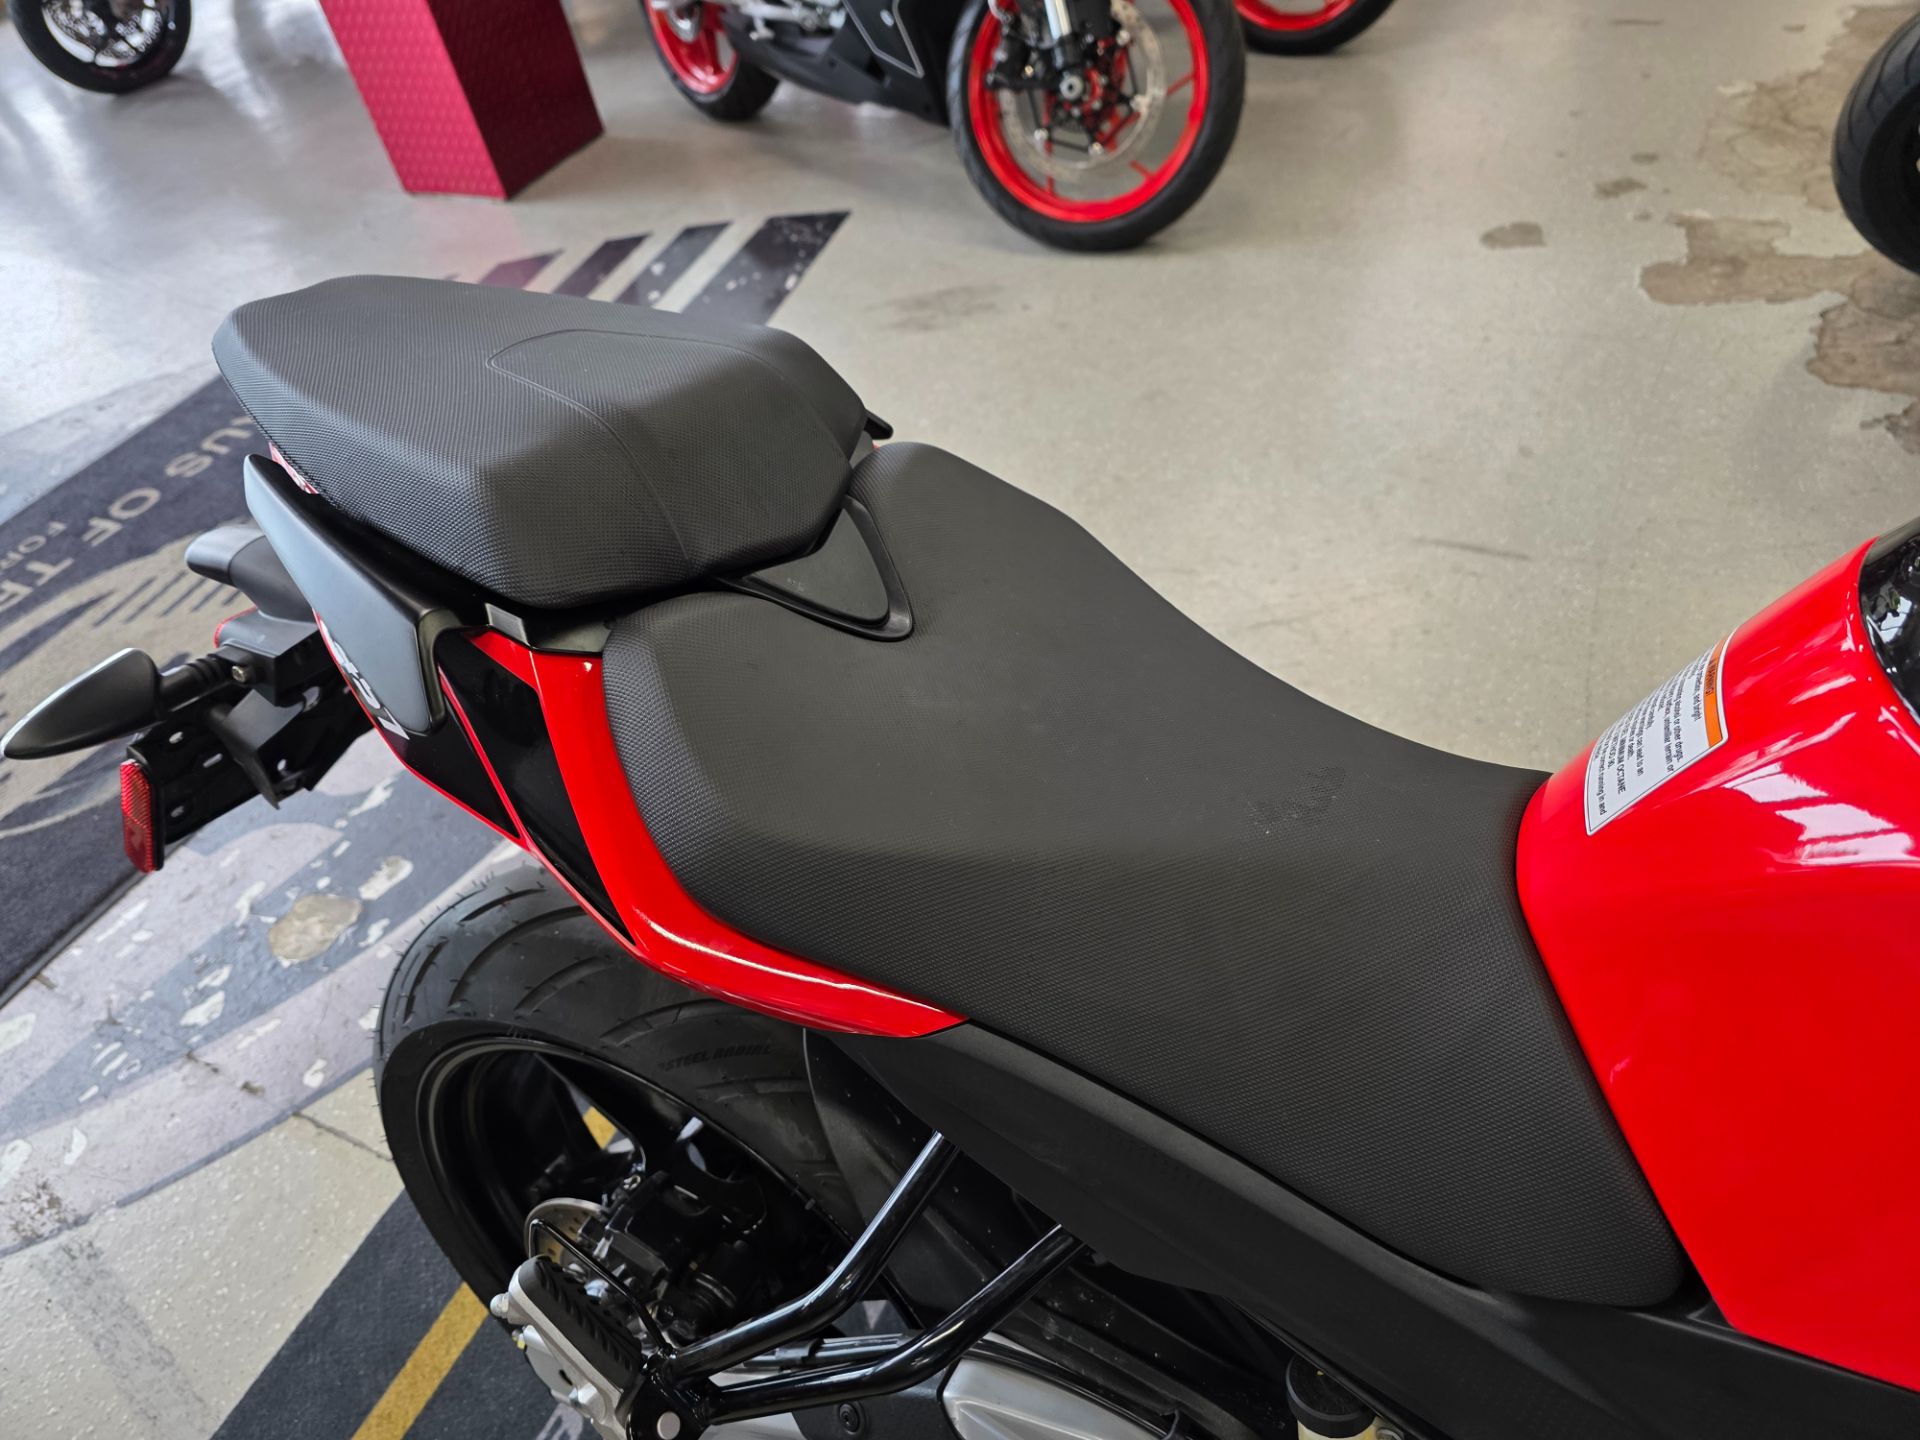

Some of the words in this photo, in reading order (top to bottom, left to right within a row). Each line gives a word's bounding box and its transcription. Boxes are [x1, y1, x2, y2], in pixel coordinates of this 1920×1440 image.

[164, 415, 256, 479] US
[80, 486, 162, 548] OF
[1665, 743, 1673, 764] terrain
[1674, 741, 1684, 762] drugs.
[1616, 764, 1626, 795] OCTANE
[1637, 766, 1644, 776] an
[1666, 765, 1674, 773] or
[1599, 802, 1608, 816] and
